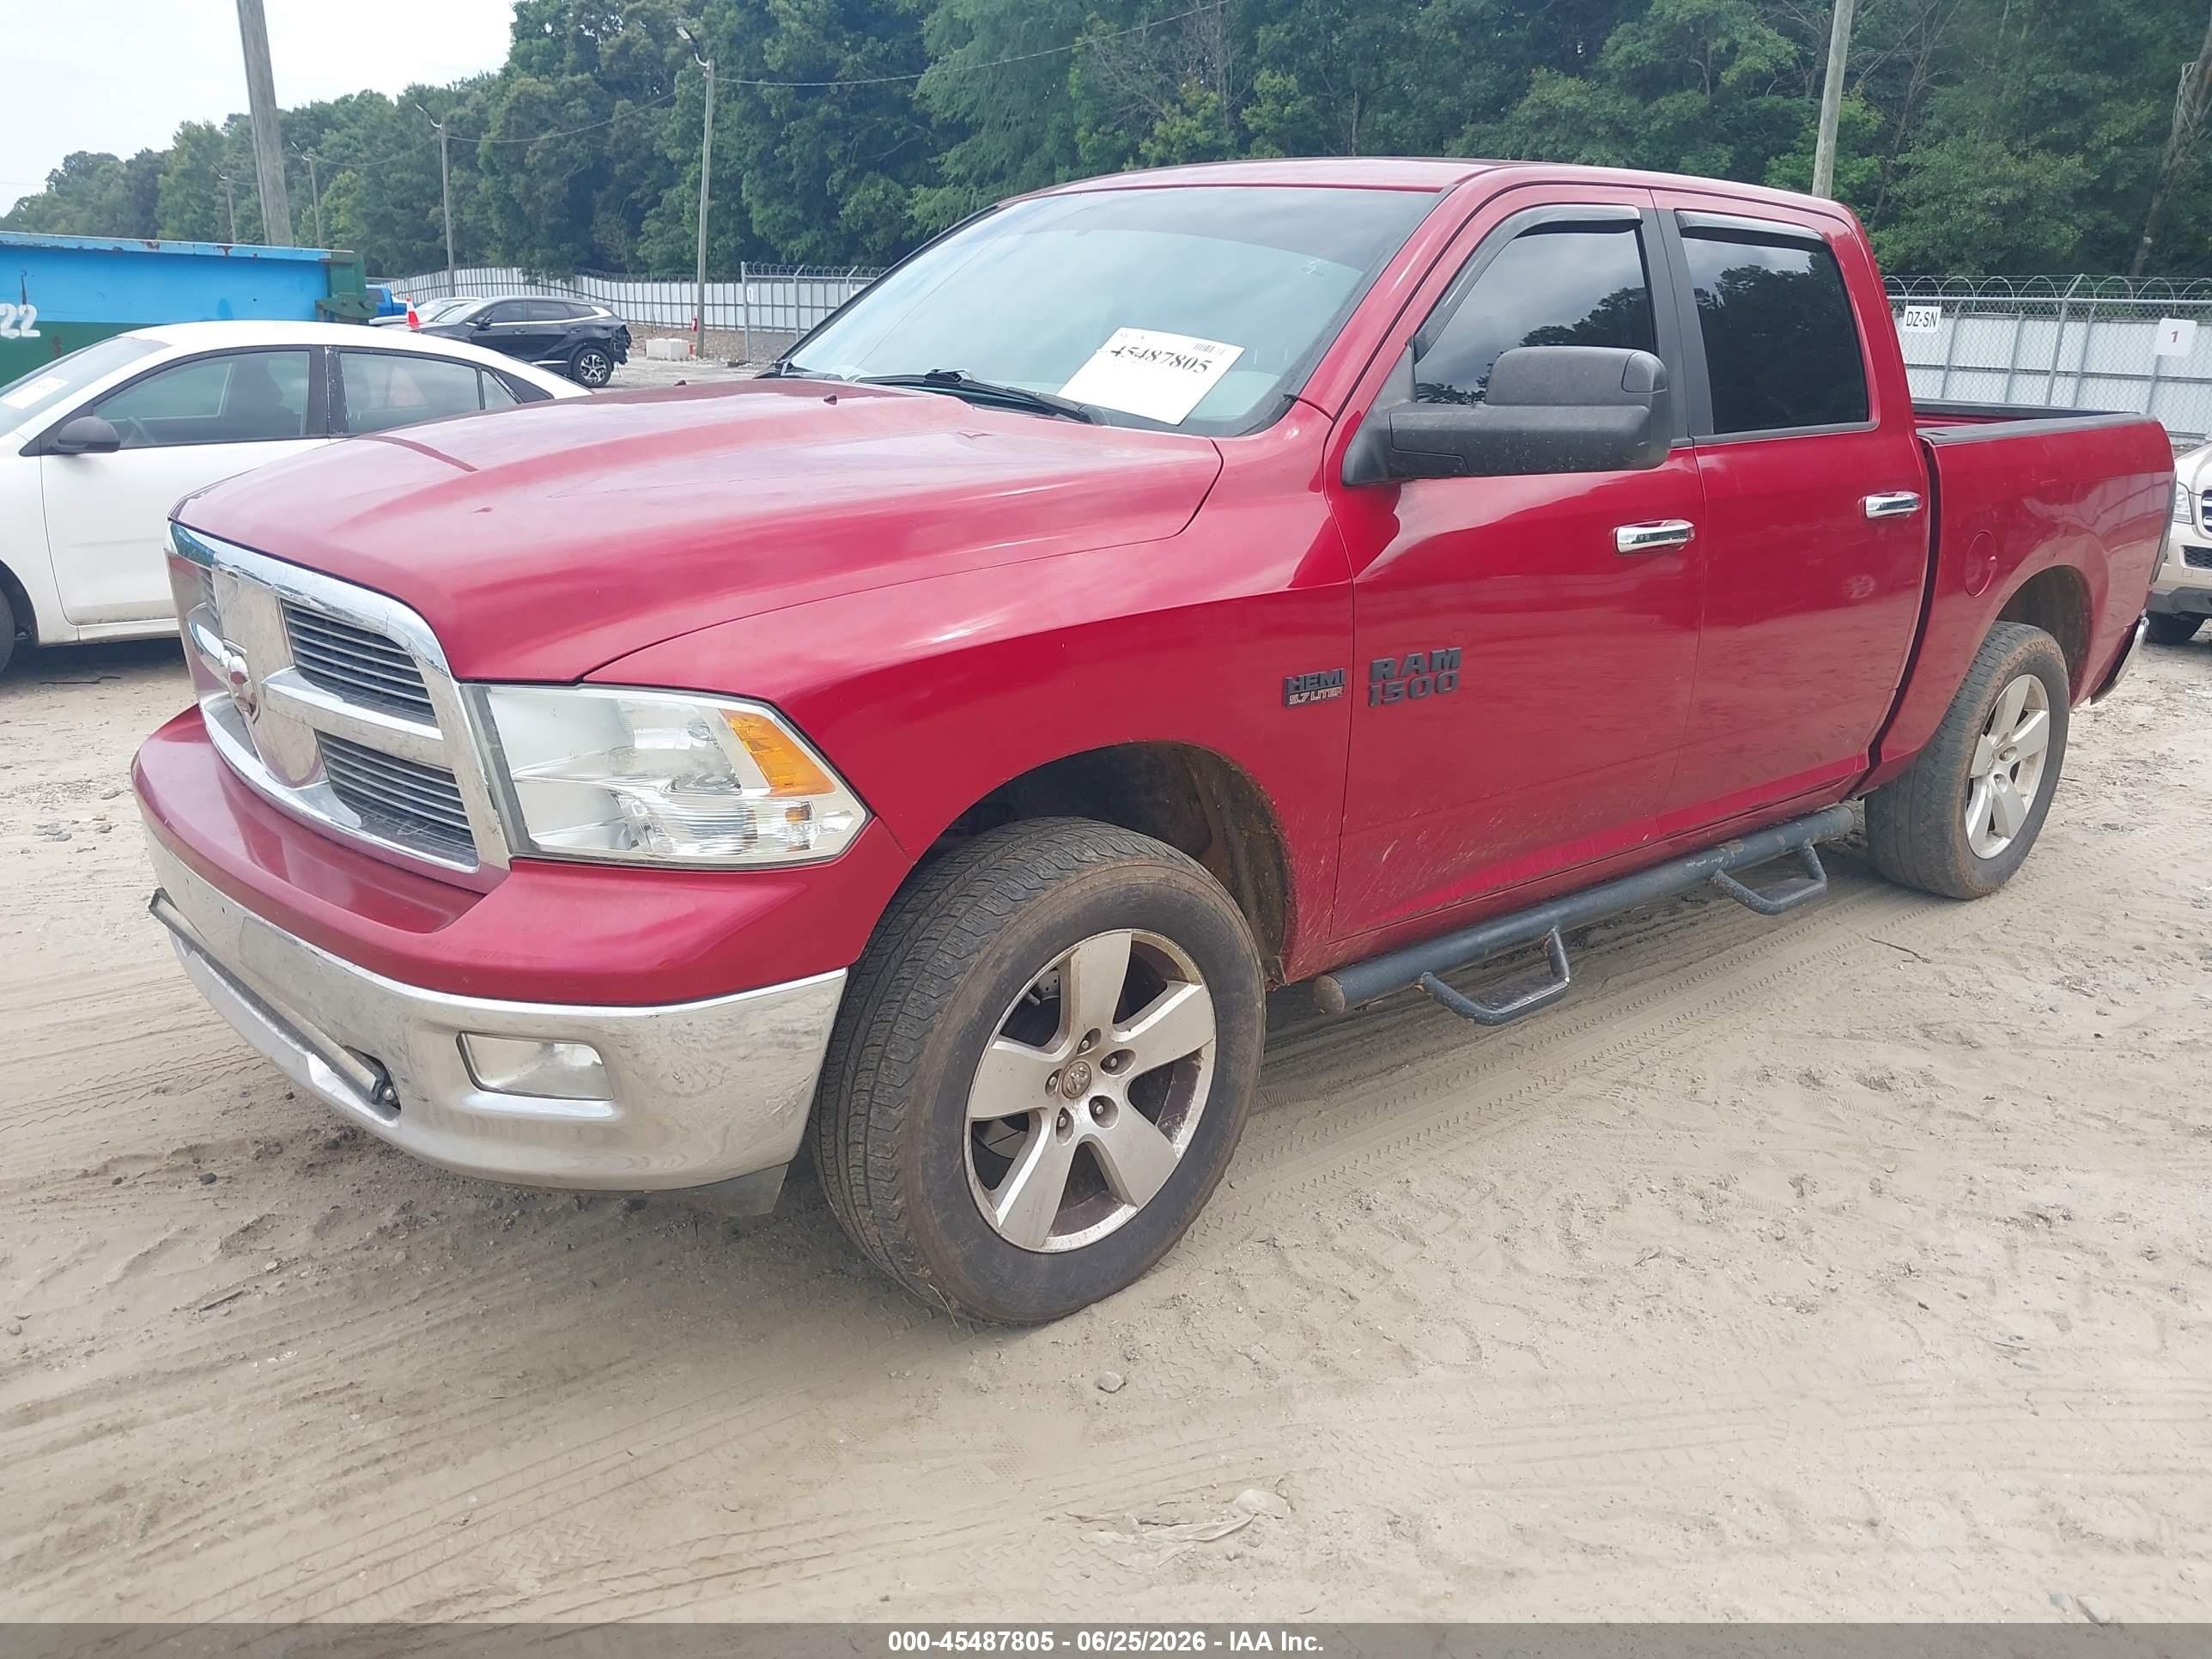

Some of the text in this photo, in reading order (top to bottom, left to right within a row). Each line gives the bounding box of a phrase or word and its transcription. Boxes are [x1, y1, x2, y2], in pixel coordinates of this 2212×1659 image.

[1906, 311, 1937, 328] DZ-SN
[2171, 330, 2179, 343] 1
[1111, 345, 1213, 374] 45487805
[1370, 647, 1462, 683] RAM
[1285, 668, 1346, 694] HEMI
[1368, 671, 1460, 708] 1500
[1289, 686, 1344, 705] 5.7 LITER
